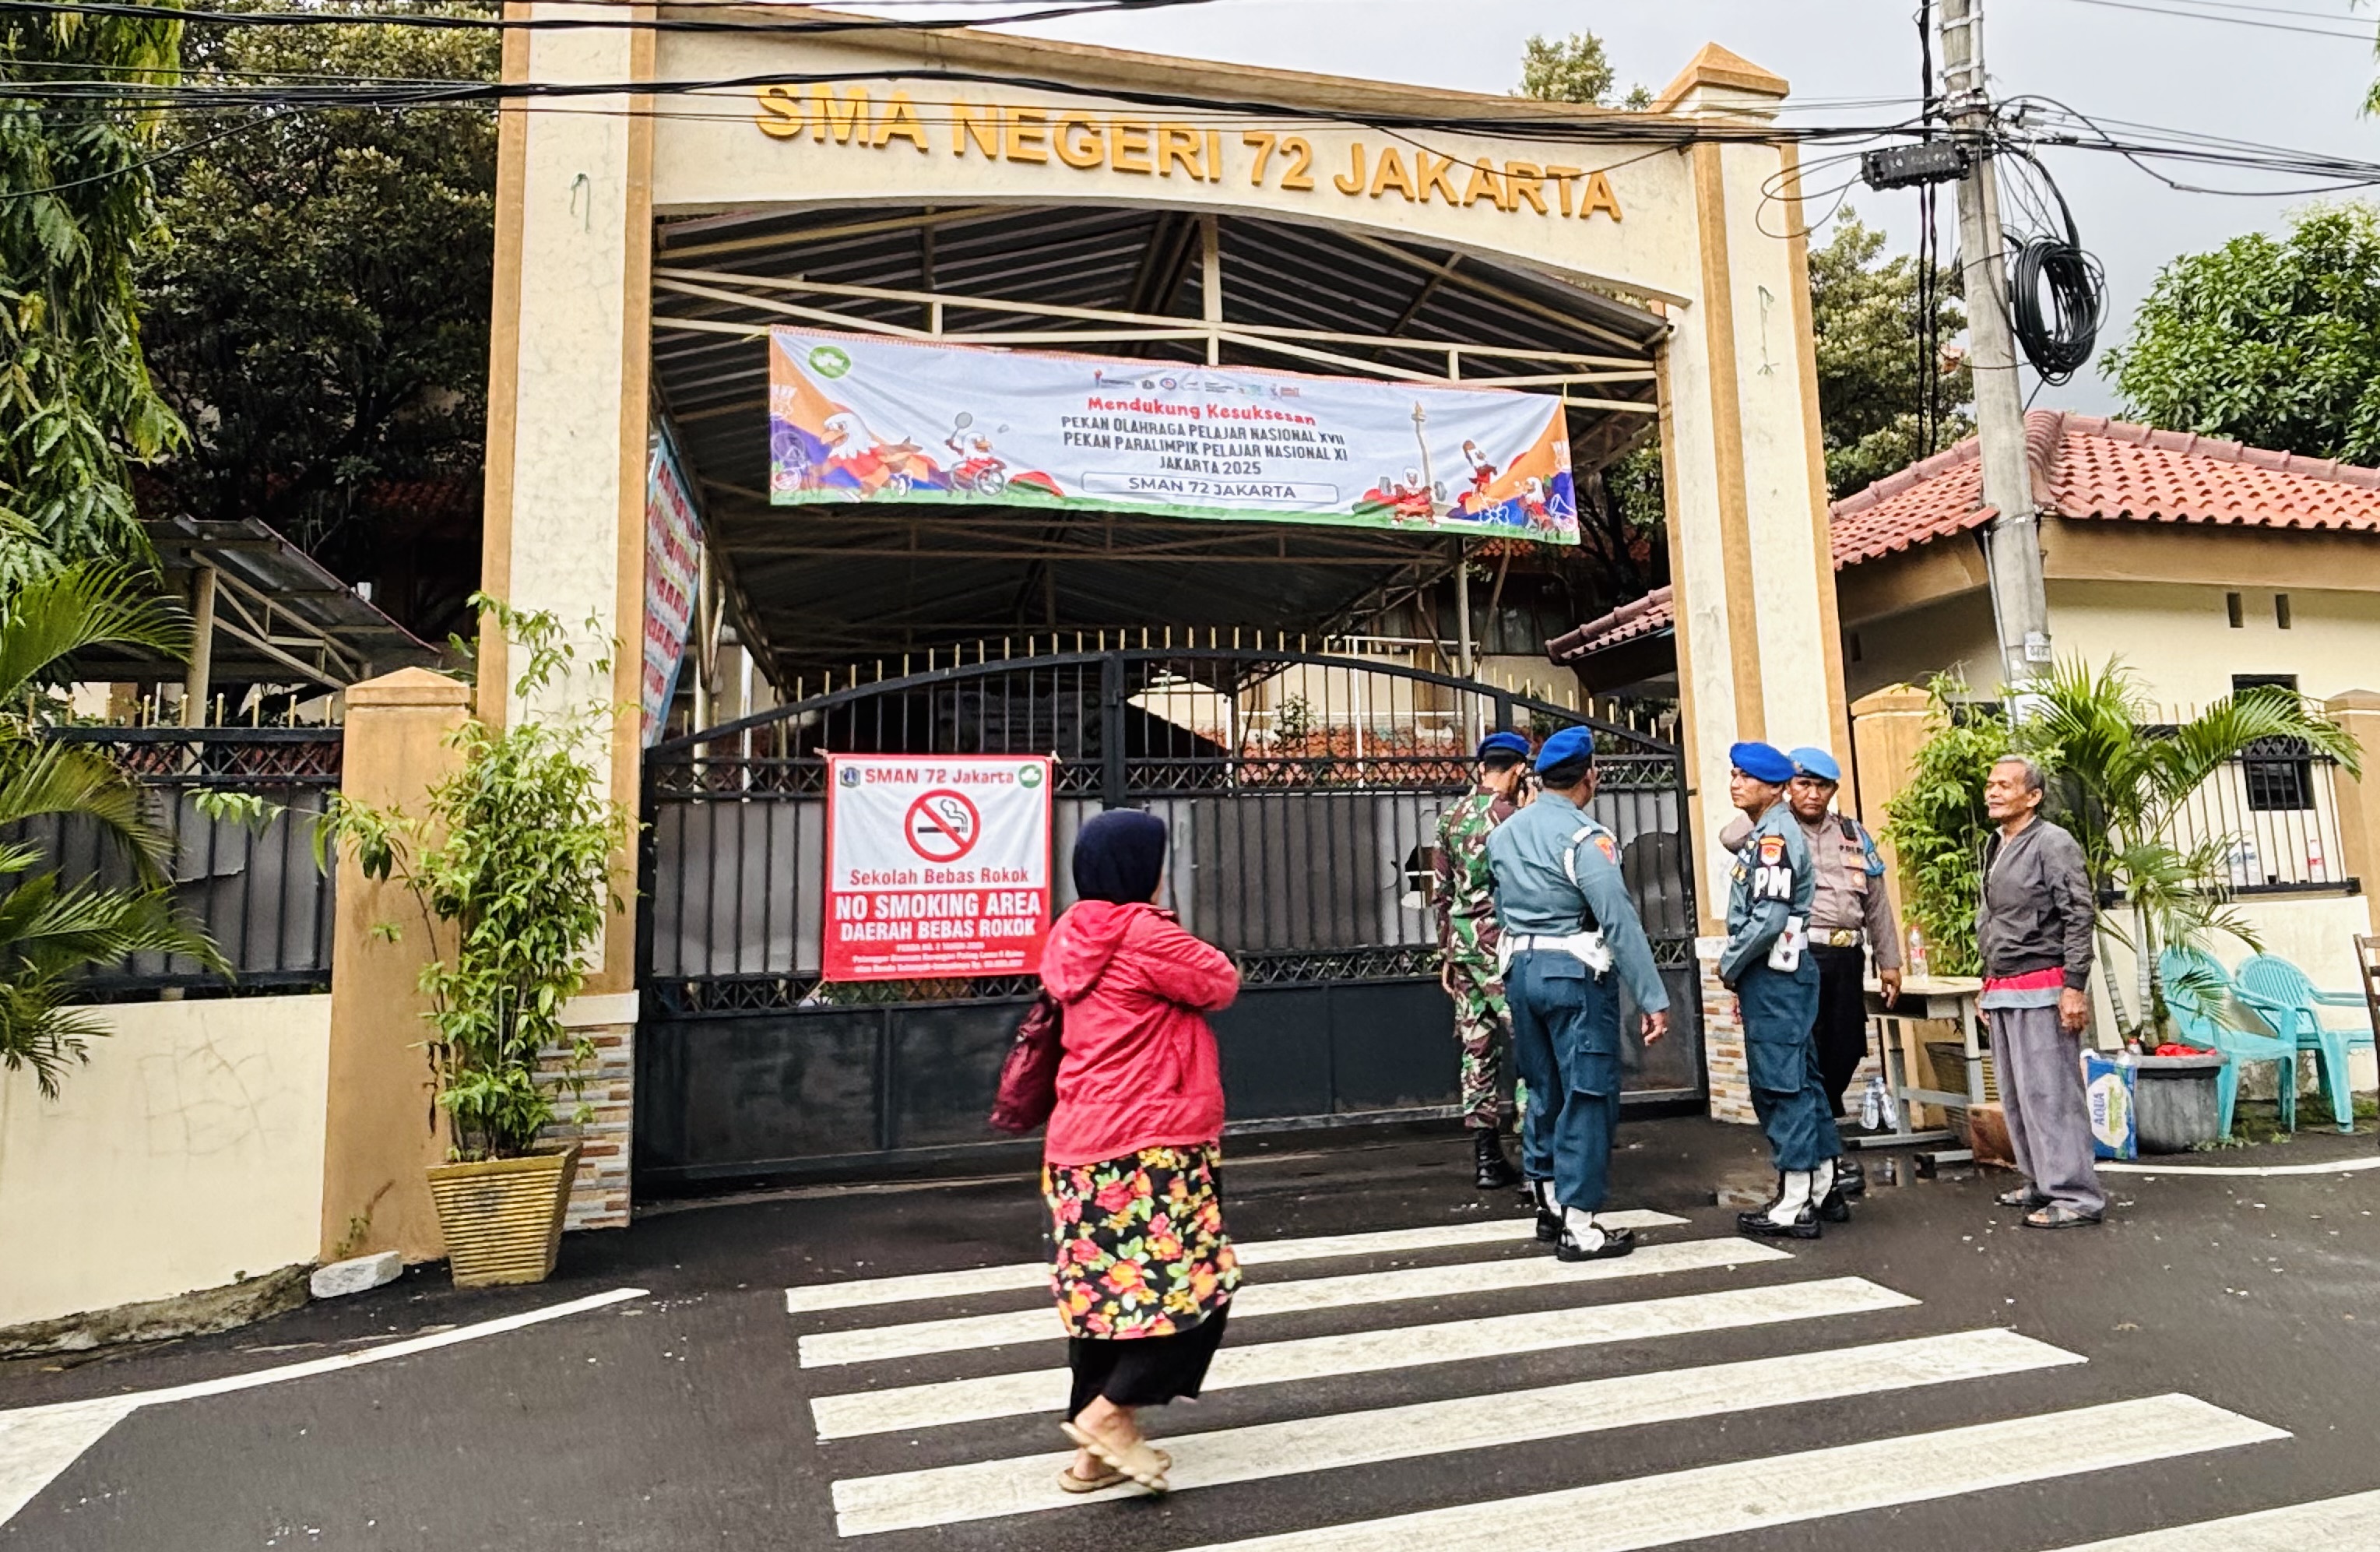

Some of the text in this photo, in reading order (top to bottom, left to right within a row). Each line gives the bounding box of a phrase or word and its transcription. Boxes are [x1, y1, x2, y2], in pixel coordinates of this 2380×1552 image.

[754, 83, 1624, 222] SMA NEGERI 72 JAKARTA
[1088, 396, 1317, 427] Mendukung Kesuksesan
[1061, 416, 1345, 445] PEKAN OLAHRAGA PELAJAR NASIONAL XVII
[1063, 431, 1348, 462] PEKAN PARALIMPIK PELAJAR NASIONAL XI
[1159, 456, 1262, 475] JAKARTA 2025
[1129, 477, 1297, 499] SMAN 72 JAKARTA
[865, 768, 1014, 784] SMAN 72 Jakarta
[849, 868, 1029, 885] Sekolah Bebas Rokok
[1752, 866, 1792, 899] PM
[835, 892, 1041, 920] NO SMOKING AREA
[841, 918, 1035, 941] DAERAH BEBAS ROKOK
[2093, 1093, 2107, 1126] AQUA
